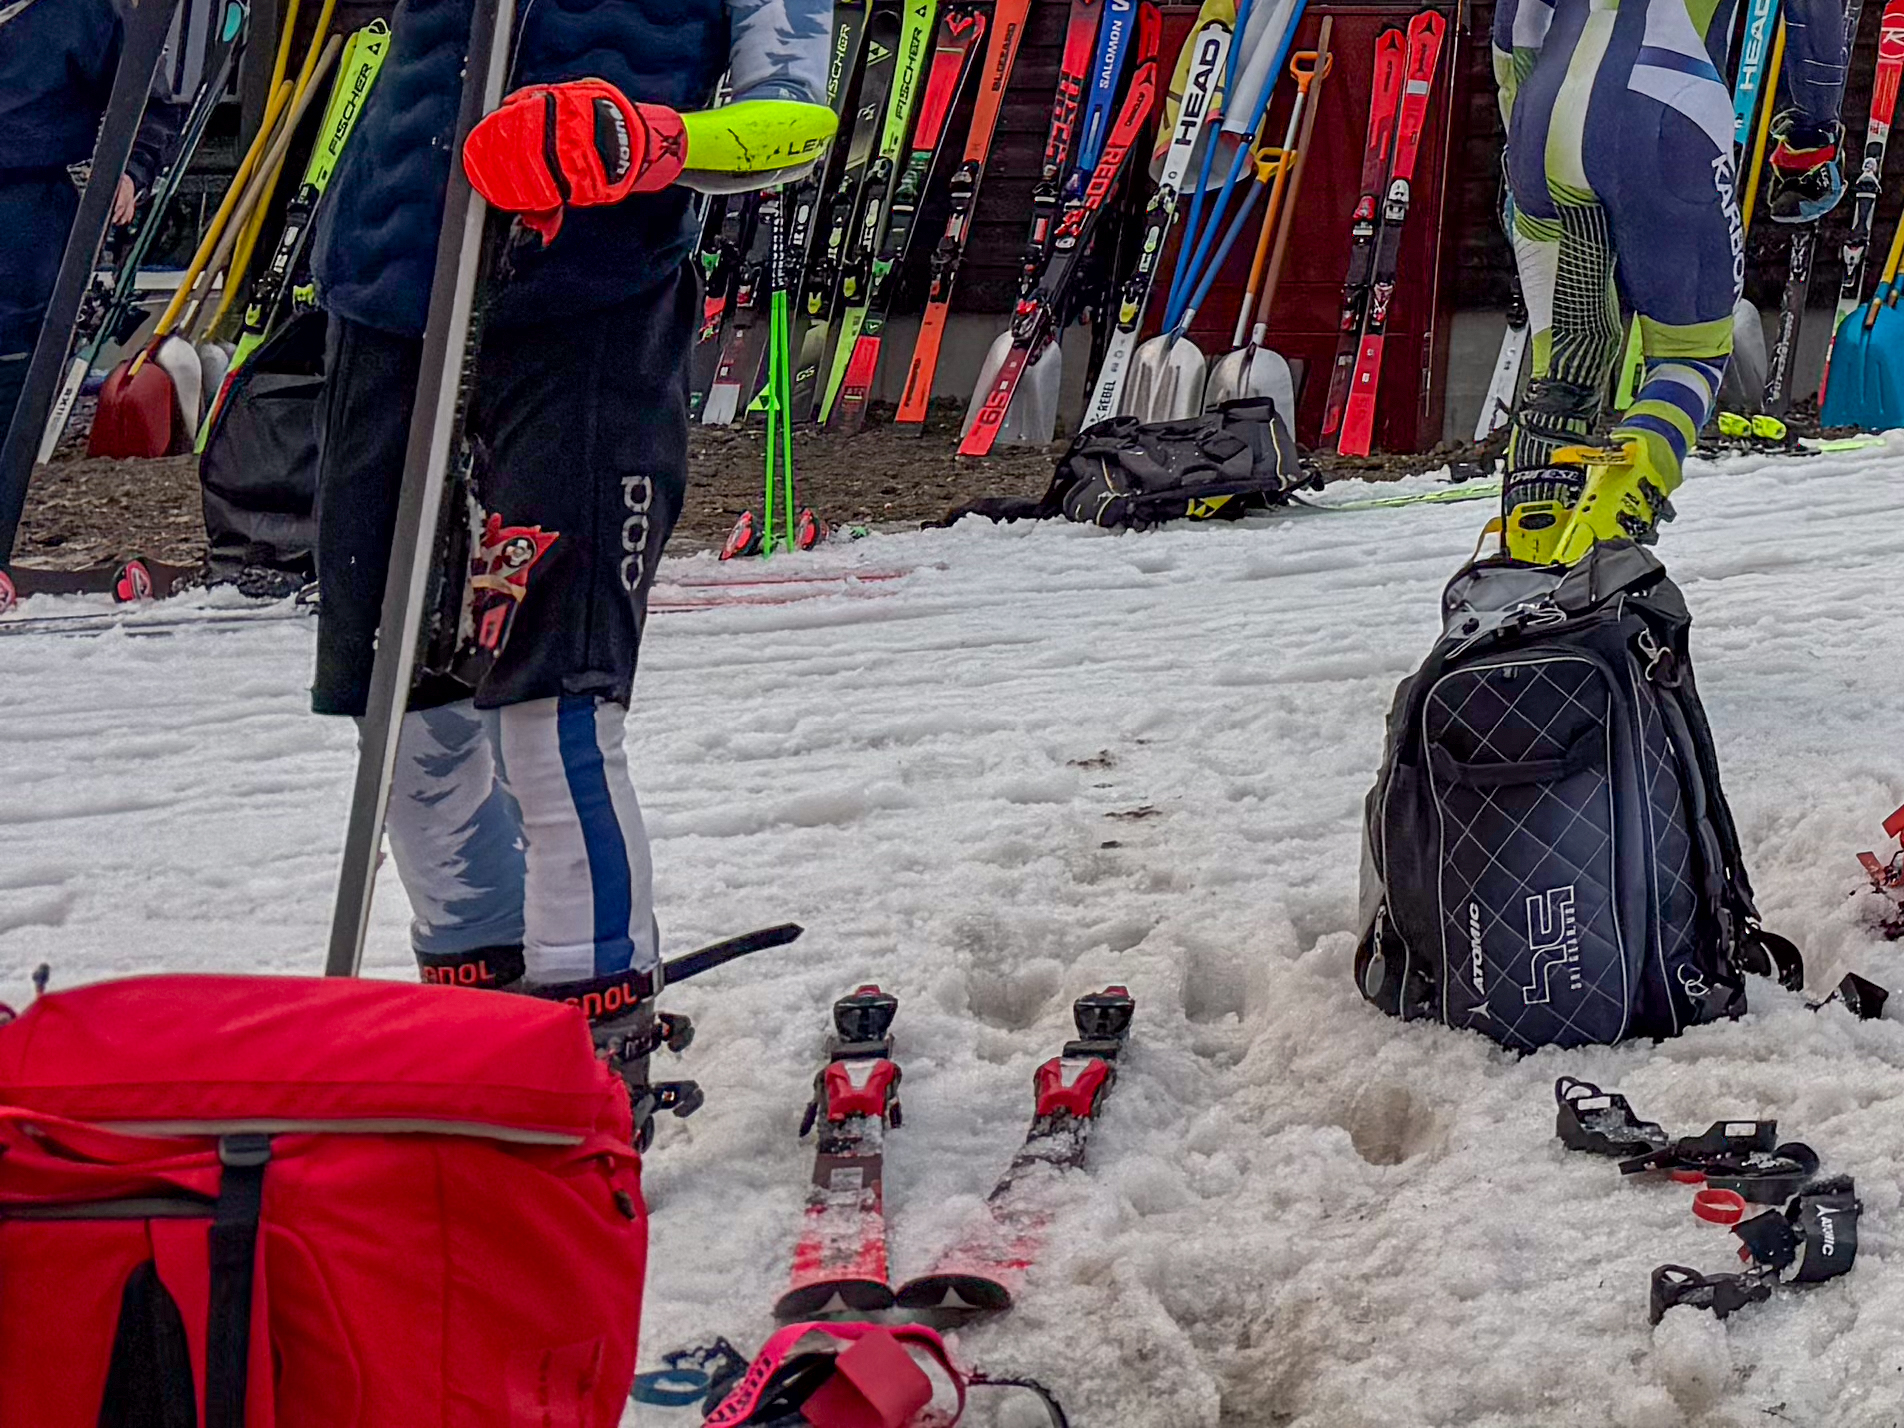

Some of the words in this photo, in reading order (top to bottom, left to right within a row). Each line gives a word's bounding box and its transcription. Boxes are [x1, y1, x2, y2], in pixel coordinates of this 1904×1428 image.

[827, 22, 851, 106] ISCHER
[894, 26, 923, 121] FISCHER
[1098, 19, 1124, 90] SALOMON
[1173, 38, 1221, 147] HEAD
[328, 62, 373, 156] FISCHER
[1469, 902, 1486, 996] ATOMIC
